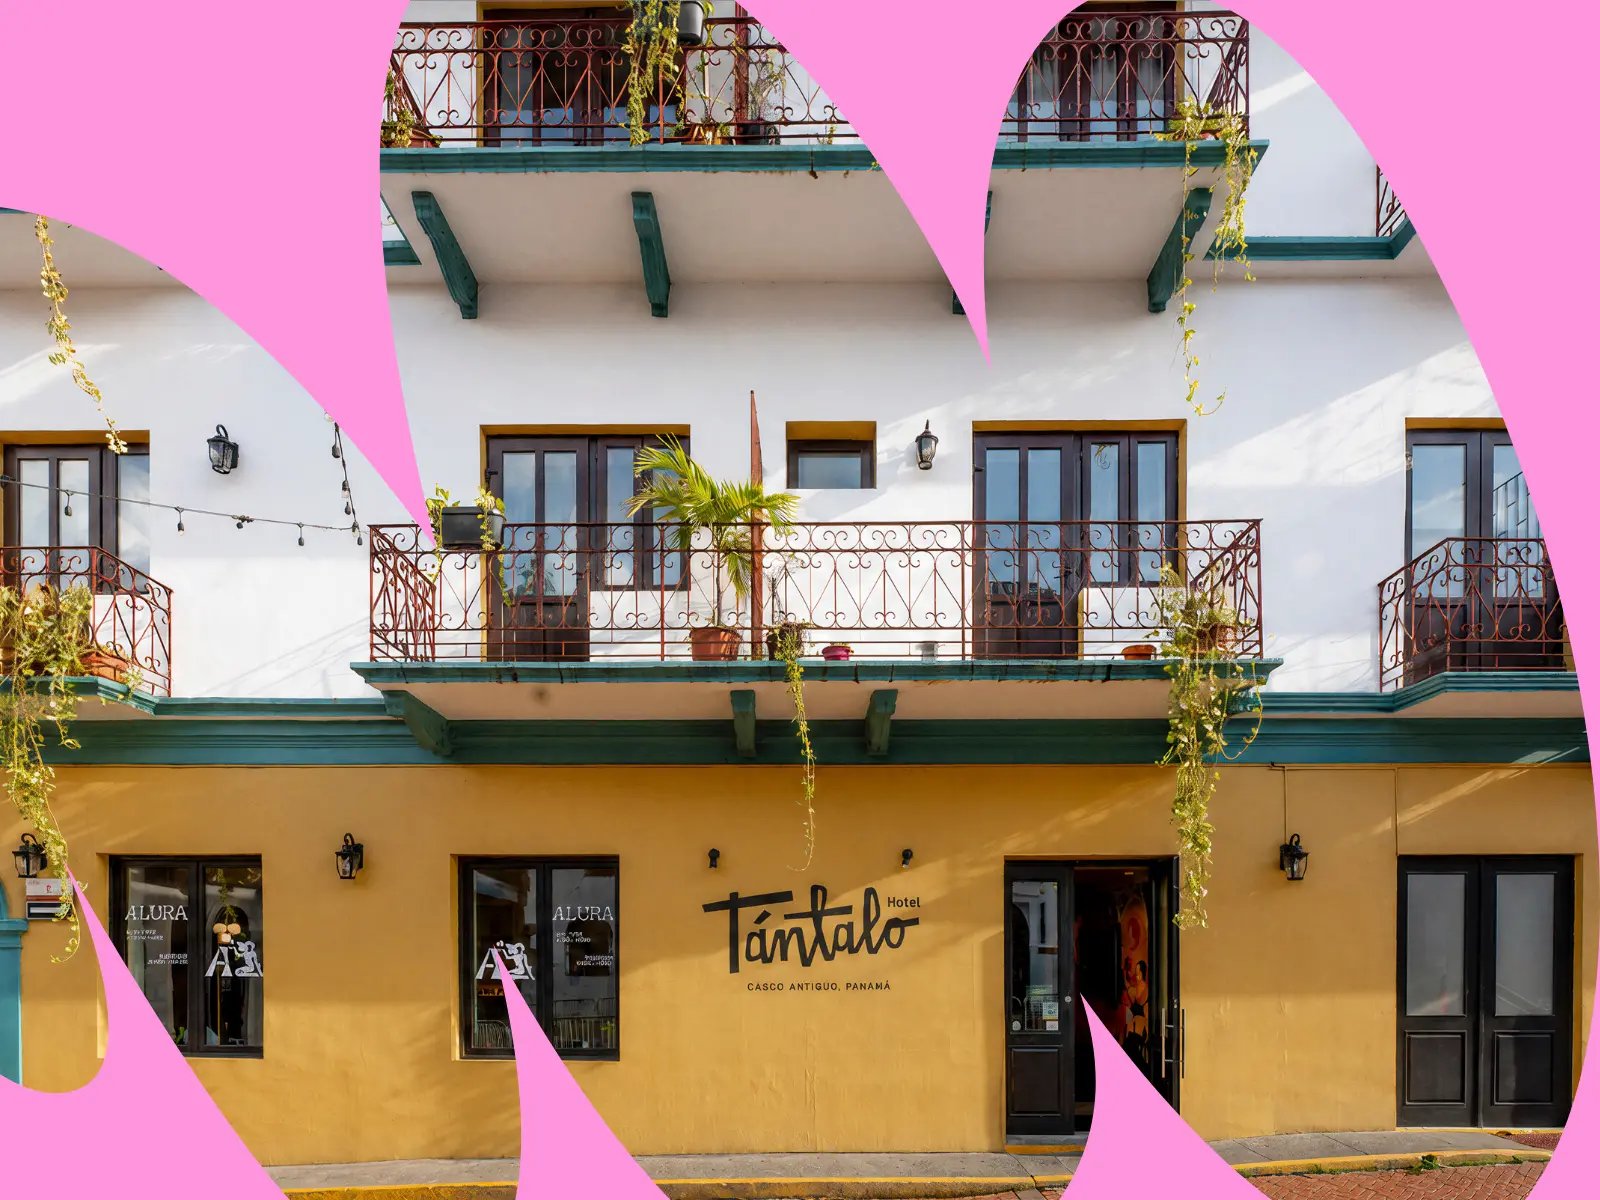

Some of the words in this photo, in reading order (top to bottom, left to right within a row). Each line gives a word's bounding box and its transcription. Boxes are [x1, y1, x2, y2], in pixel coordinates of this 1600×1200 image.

[887, 897, 921, 908] Hotel
[125, 904, 188, 921] ALURA
[552, 906, 614, 921] ALURA
[702, 884, 920, 974] Tántalo
[747, 982, 784, 991] CASCO
[789, 982, 841, 992] ANTIGUO,
[846, 980, 891, 991] PANAMÁ
